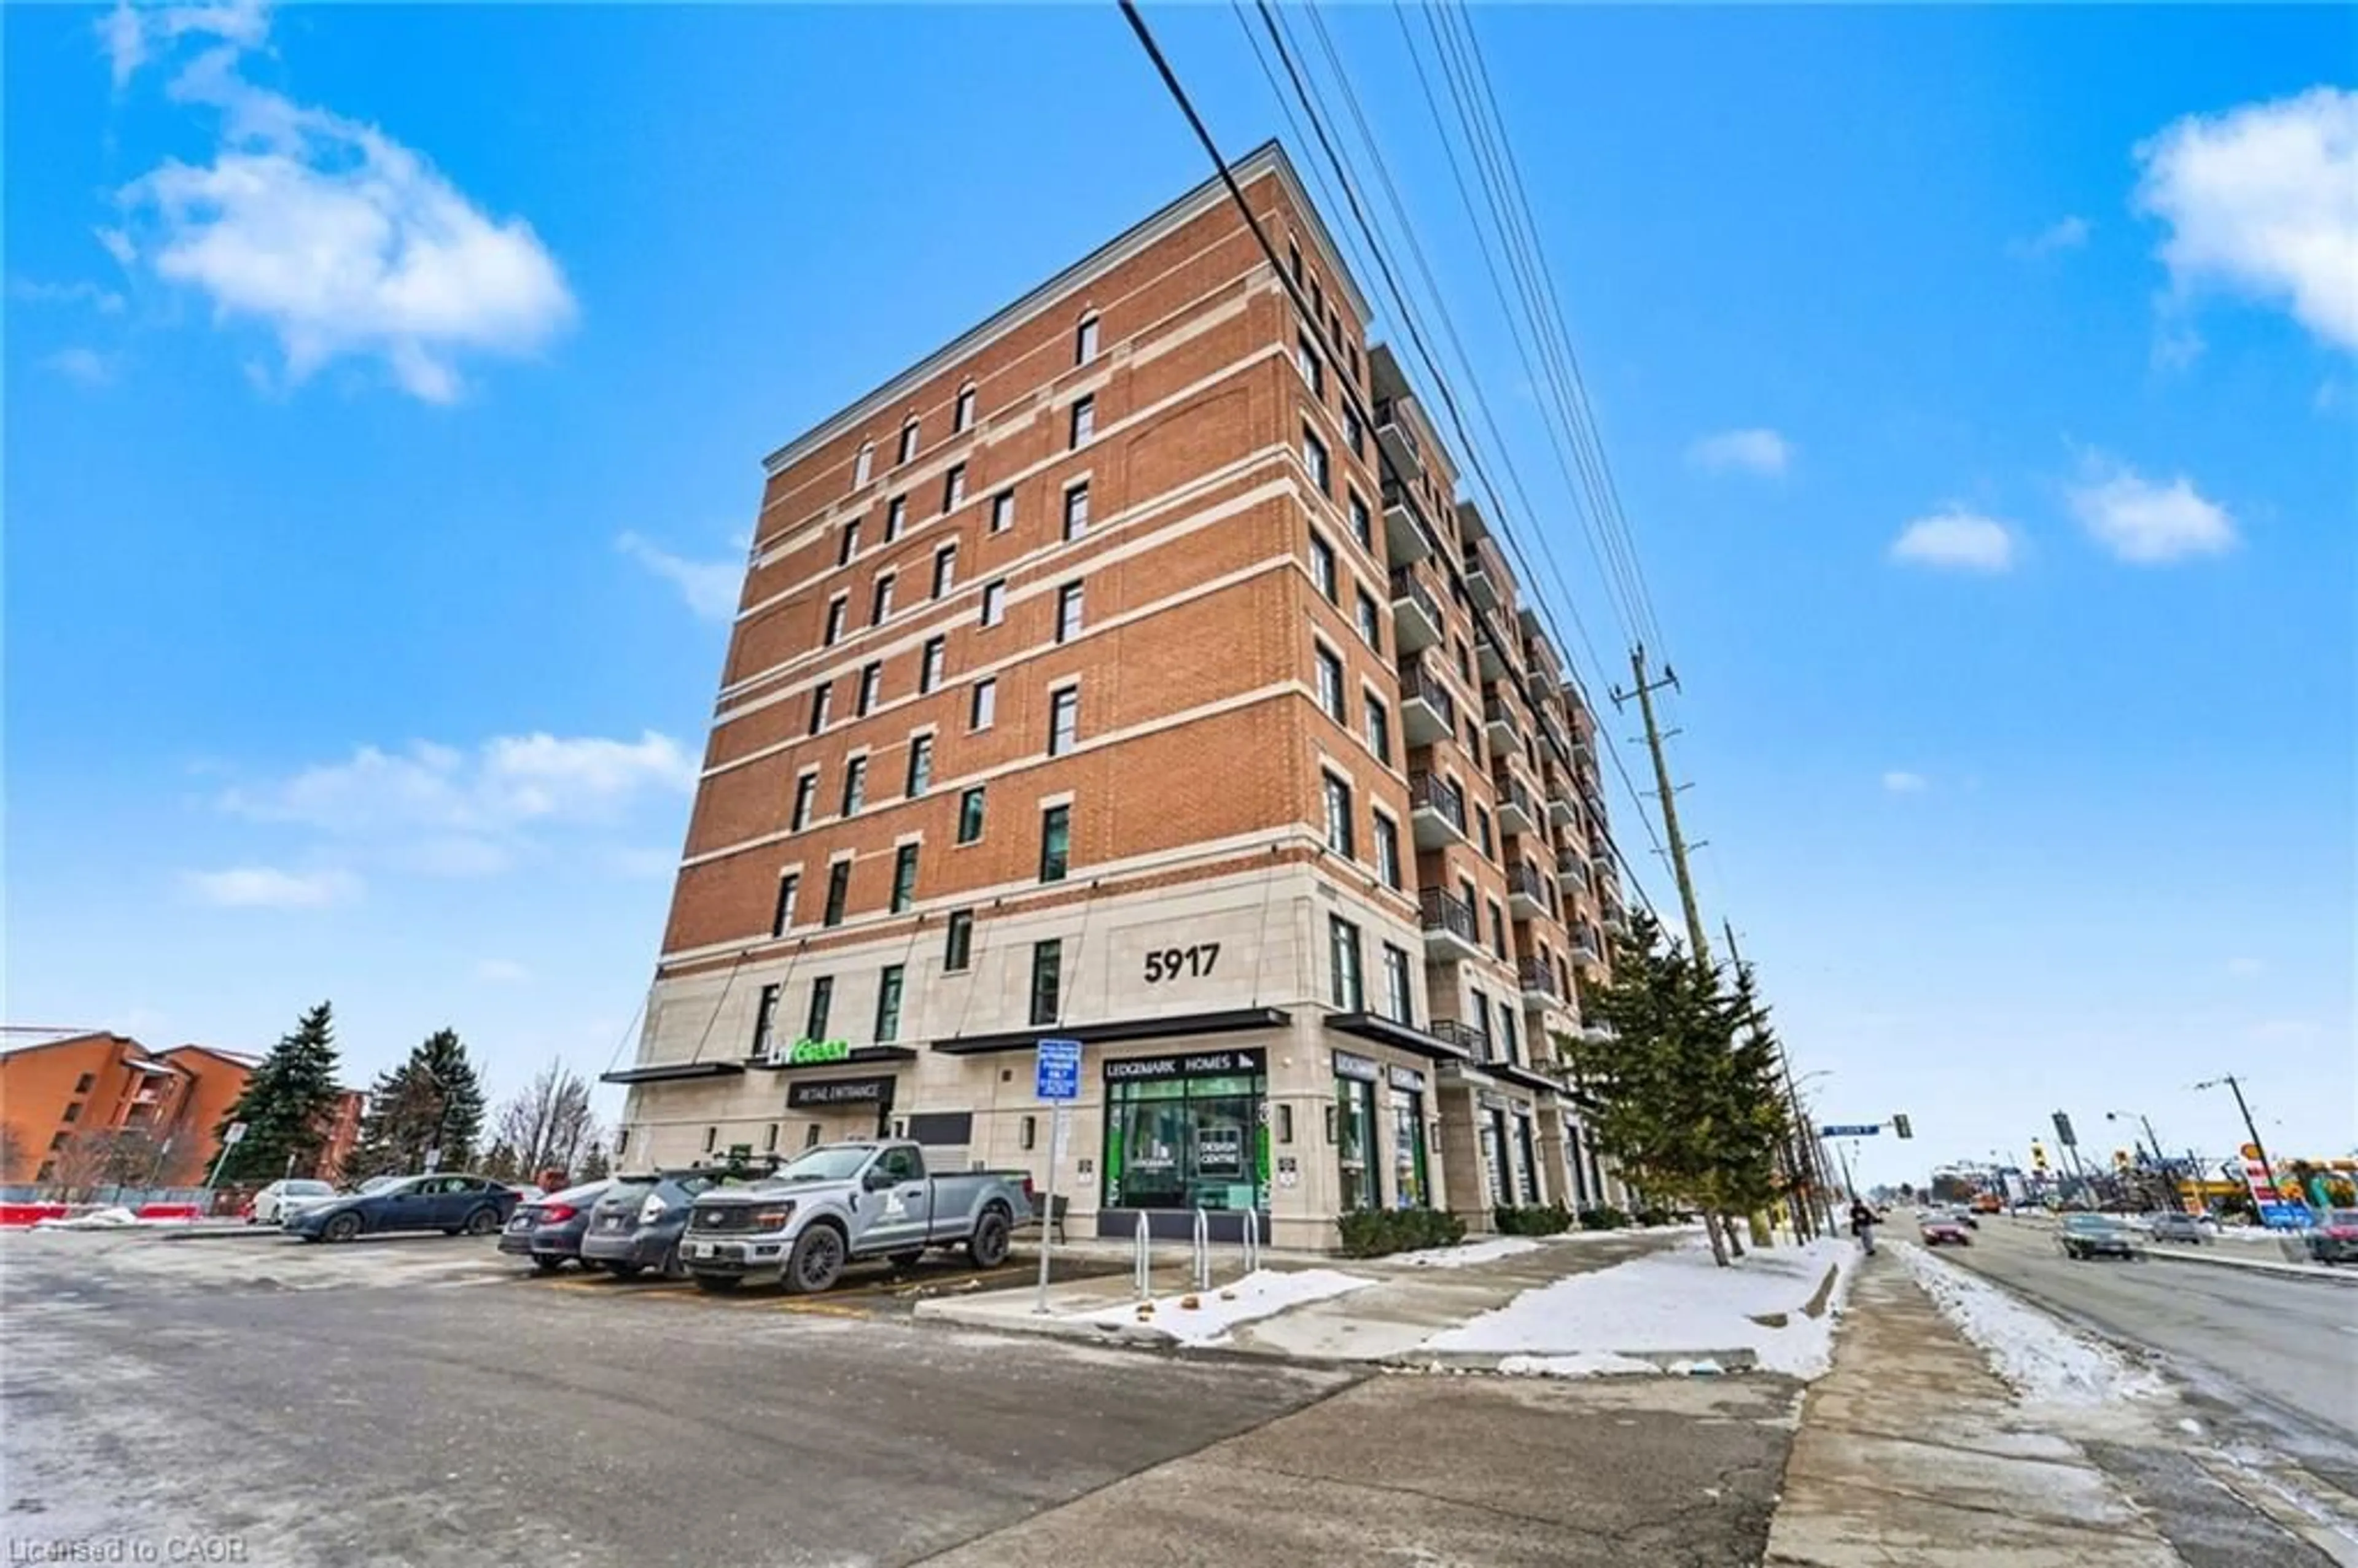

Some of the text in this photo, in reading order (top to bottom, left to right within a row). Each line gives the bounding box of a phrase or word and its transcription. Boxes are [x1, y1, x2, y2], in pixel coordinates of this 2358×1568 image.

[1144, 942, 1221, 984] 5917
[1107, 1055, 1231, 1076] LEDGEMARK HOMES
[1200, 1153, 1237, 1165] CENTRE
